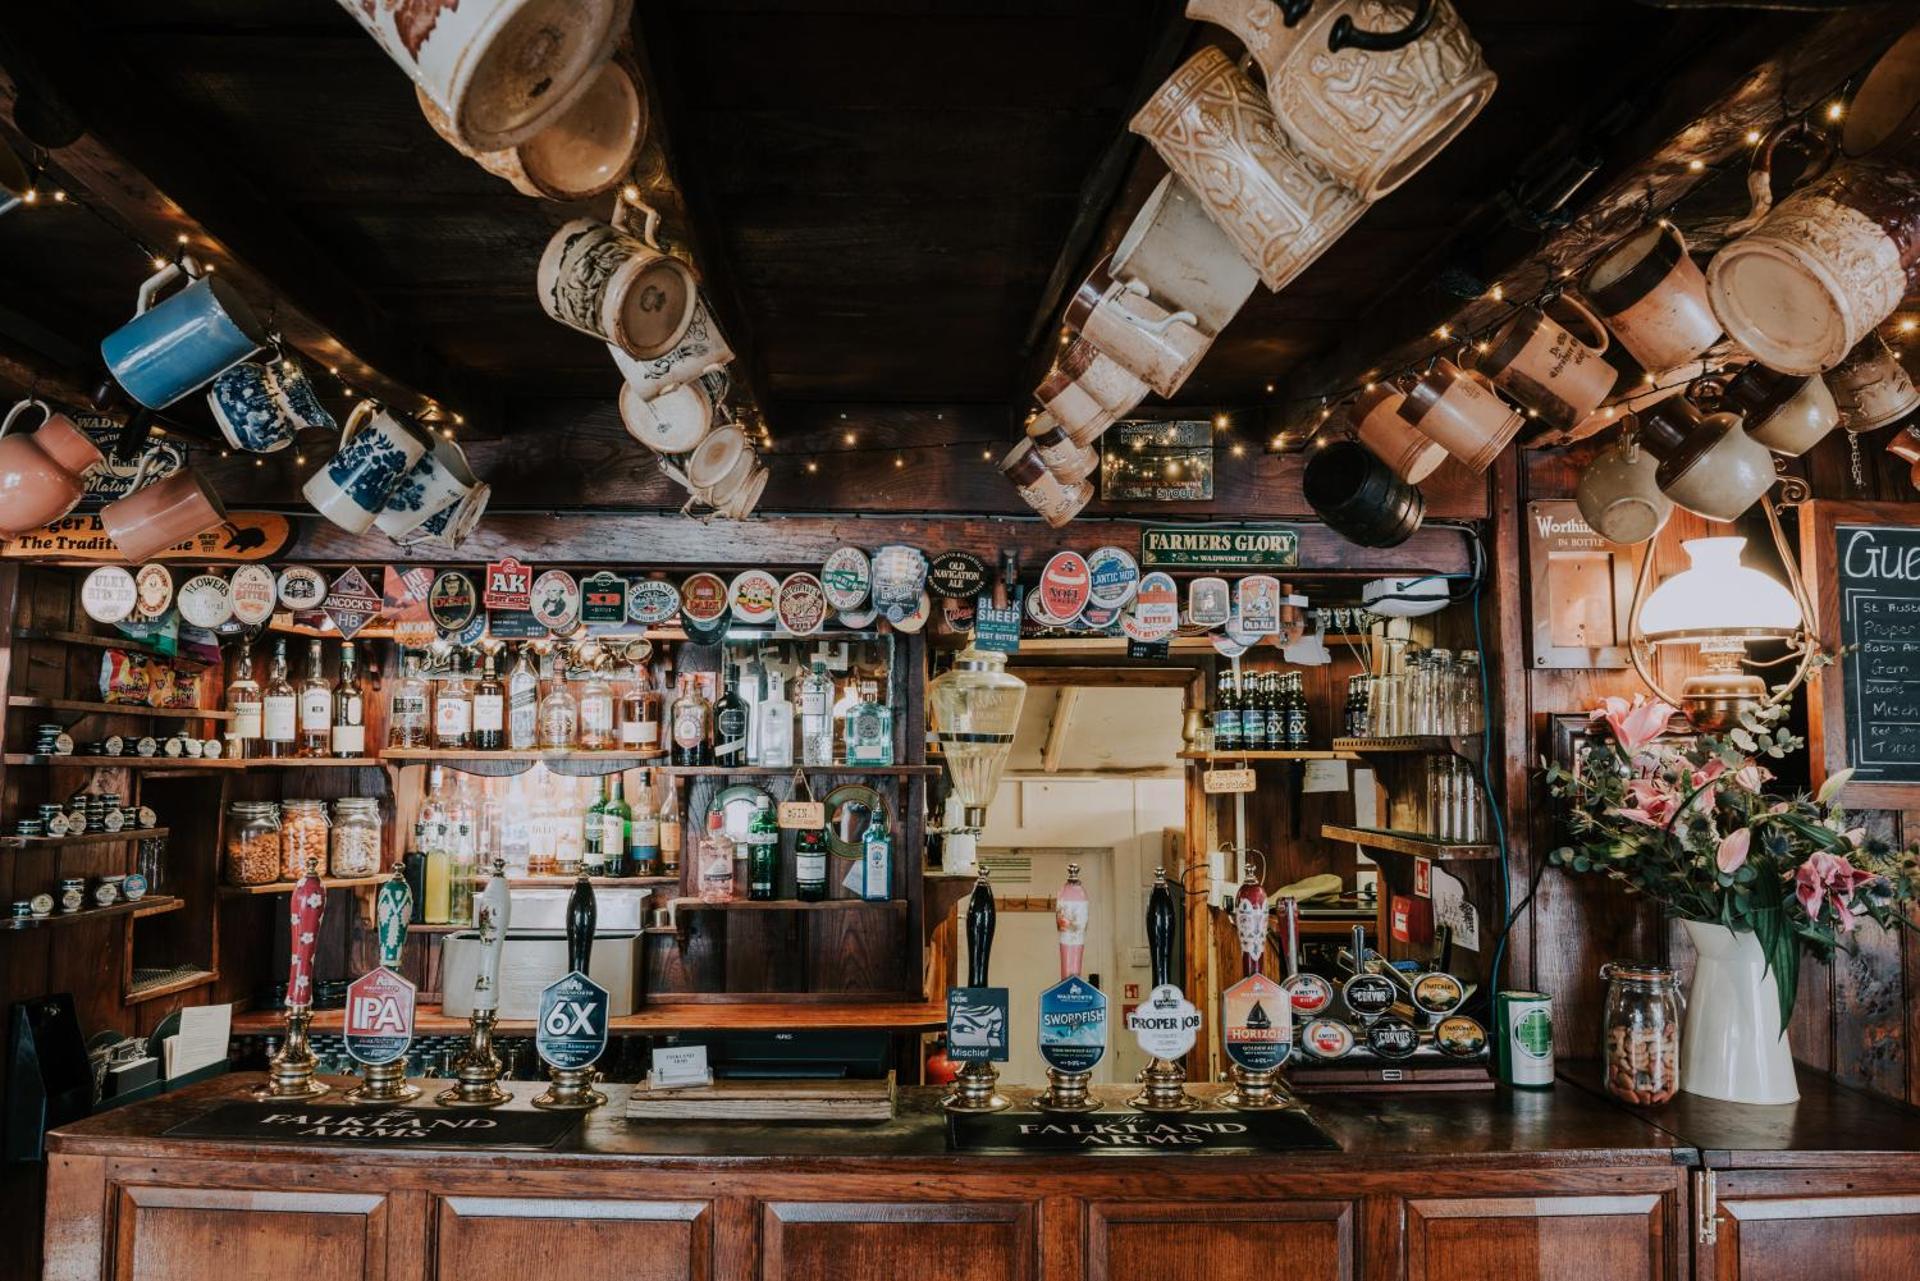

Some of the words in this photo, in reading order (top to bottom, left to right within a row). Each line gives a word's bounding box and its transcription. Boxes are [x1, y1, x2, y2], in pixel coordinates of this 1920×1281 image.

[42, 516, 85, 533] ger
[19, 535, 52, 549] The
[1149, 534, 1231, 551] FARMERS
[1234, 535, 1292, 551] GLORY
[1572, 538, 1605, 547] BOTTLE
[949, 561, 966, 571] OLD
[933, 568, 980, 581] NAVIGATION
[1092, 573, 1119, 584] LANTIC
[184, 577, 230, 598] FLOWERS
[491, 573, 528, 593] AK
[632, 582, 677, 597] MORLAND
[948, 579, 965, 589] ALE
[323, 598, 374, 610] ANCOCK'S
[338, 613, 359, 628] HB
[977, 608, 1020, 623] SHEEP
[1266, 720, 1284, 734] 6X
[1289, 720, 1307, 734] 6X
[1357, 990, 1387, 1003] CORVUS
[351, 997, 405, 1032] IPA
[546, 1001, 599, 1036] 6X
[1044, 1007, 1105, 1028] SWORDFISH
[1132, 1016, 1178, 1030] PROPER
[1181, 1015, 1201, 1031] JOB
[1231, 1028, 1287, 1040] HORIZON
[1379, 1031, 1411, 1044] CORVUS
[951, 1048, 990, 1057] Mischief
[260, 1112, 498, 1129] FALKLAND
[297, 1126, 431, 1138] ARMS
[1018, 1122, 1249, 1135] FALKLAND
[1079, 1134, 1204, 1145] ARMS
